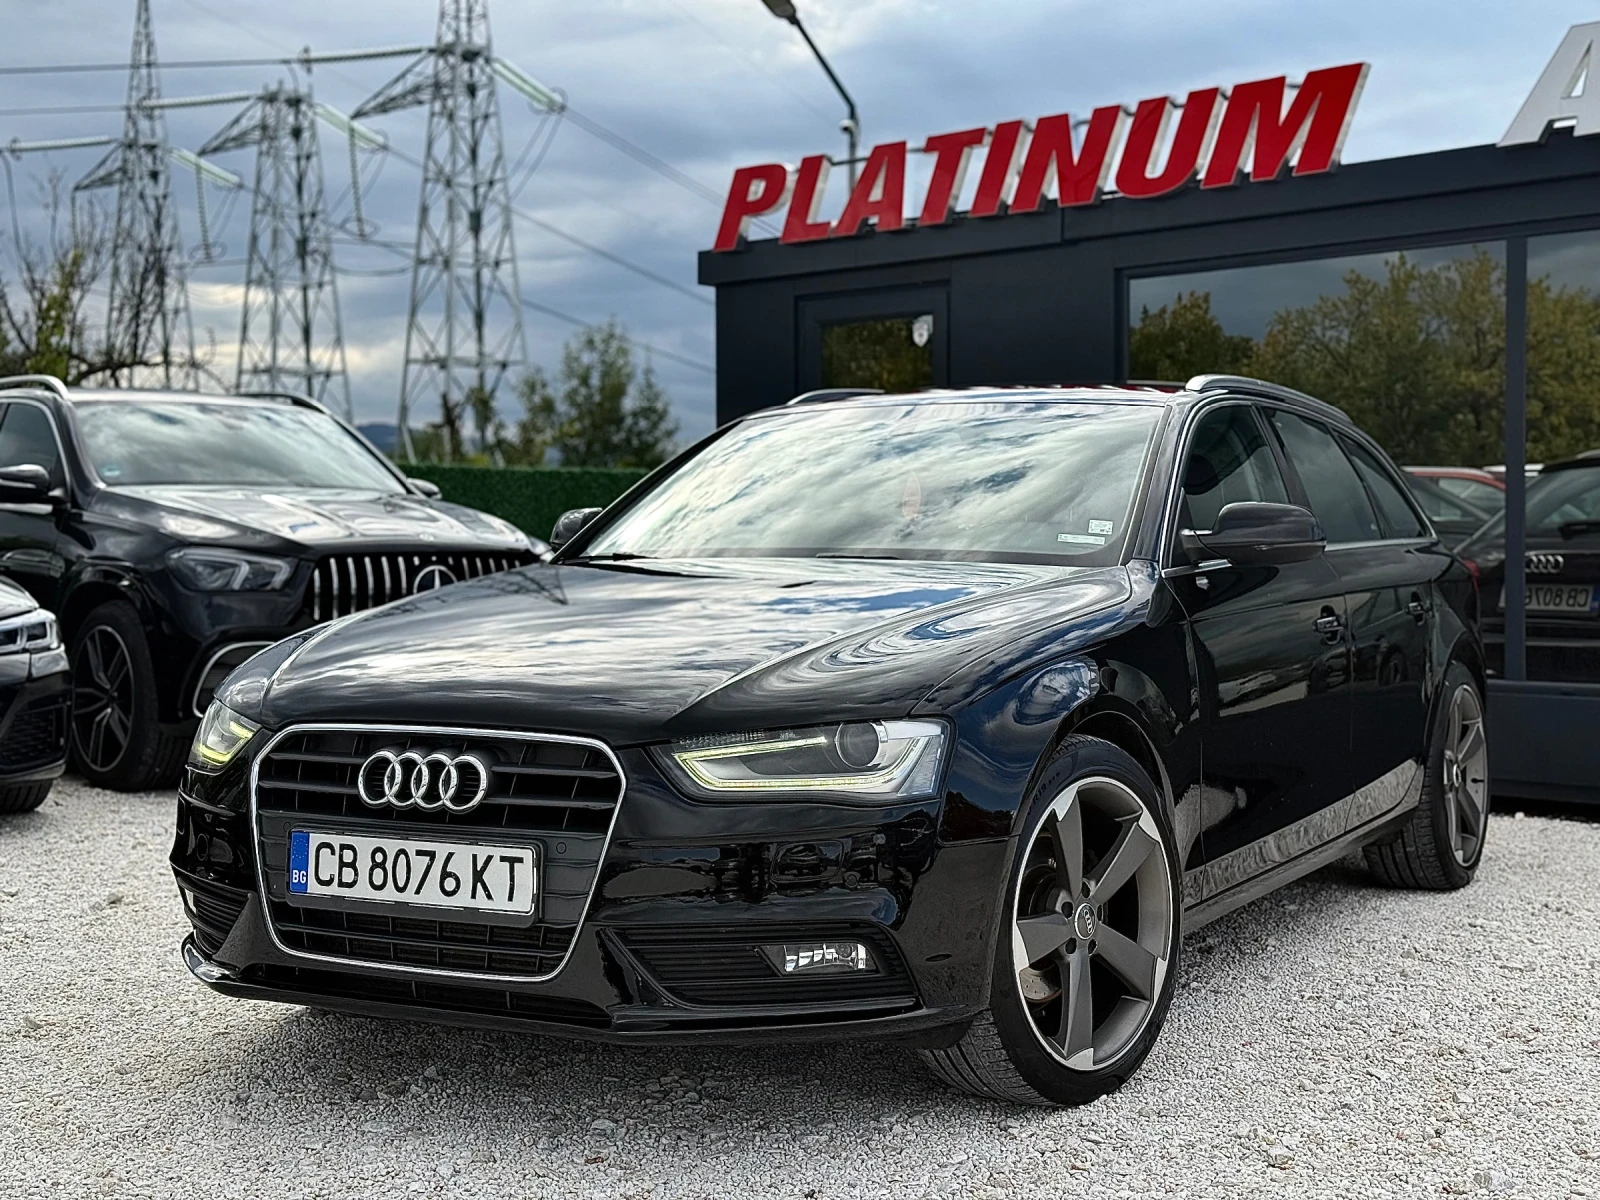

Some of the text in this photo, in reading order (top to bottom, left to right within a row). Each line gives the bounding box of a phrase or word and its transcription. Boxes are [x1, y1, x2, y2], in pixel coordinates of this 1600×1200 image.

[712, 62, 1371, 253] PLATINUM
[292, 869, 307, 884] BG
[314, 841, 524, 902] CB 8076 KT
